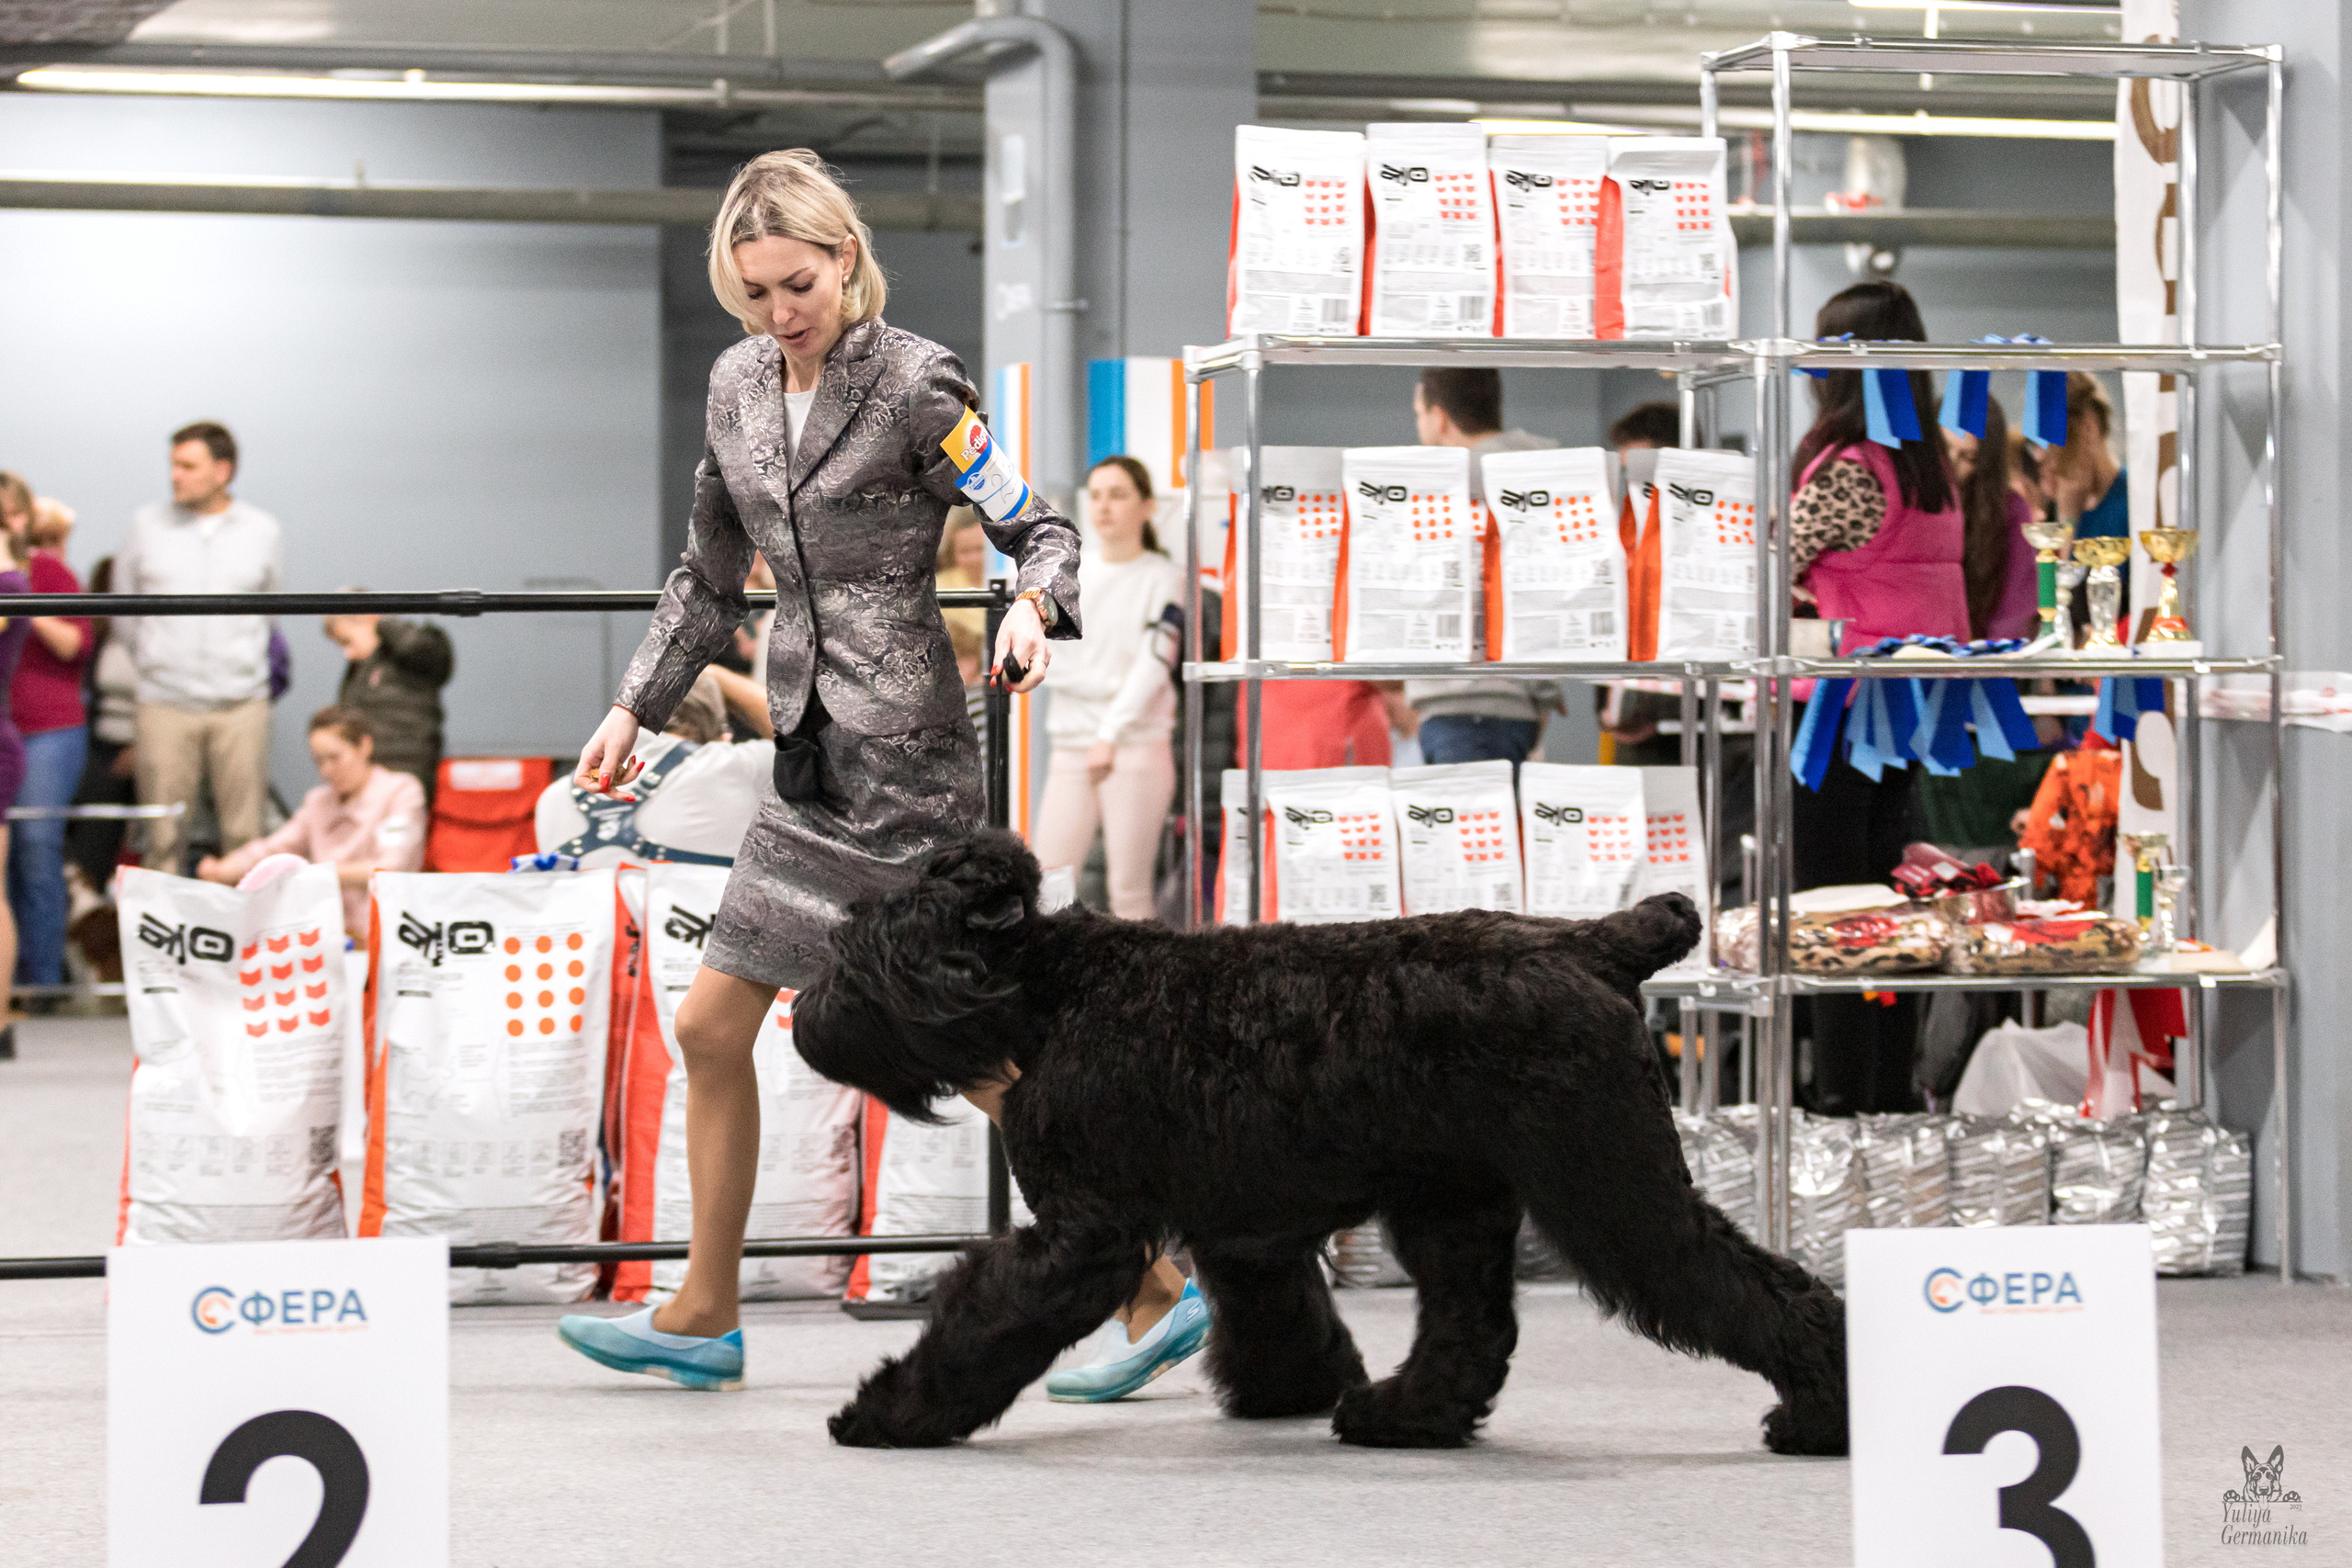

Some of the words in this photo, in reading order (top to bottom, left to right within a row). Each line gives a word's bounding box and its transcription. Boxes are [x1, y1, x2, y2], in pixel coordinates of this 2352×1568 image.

[190, 1284, 368, 1336] СФЕРА
[1923, 1266, 2084, 1314] СФЕРА
[199, 1409, 370, 1568] 2
[1942, 1385, 2098, 1568] 3
